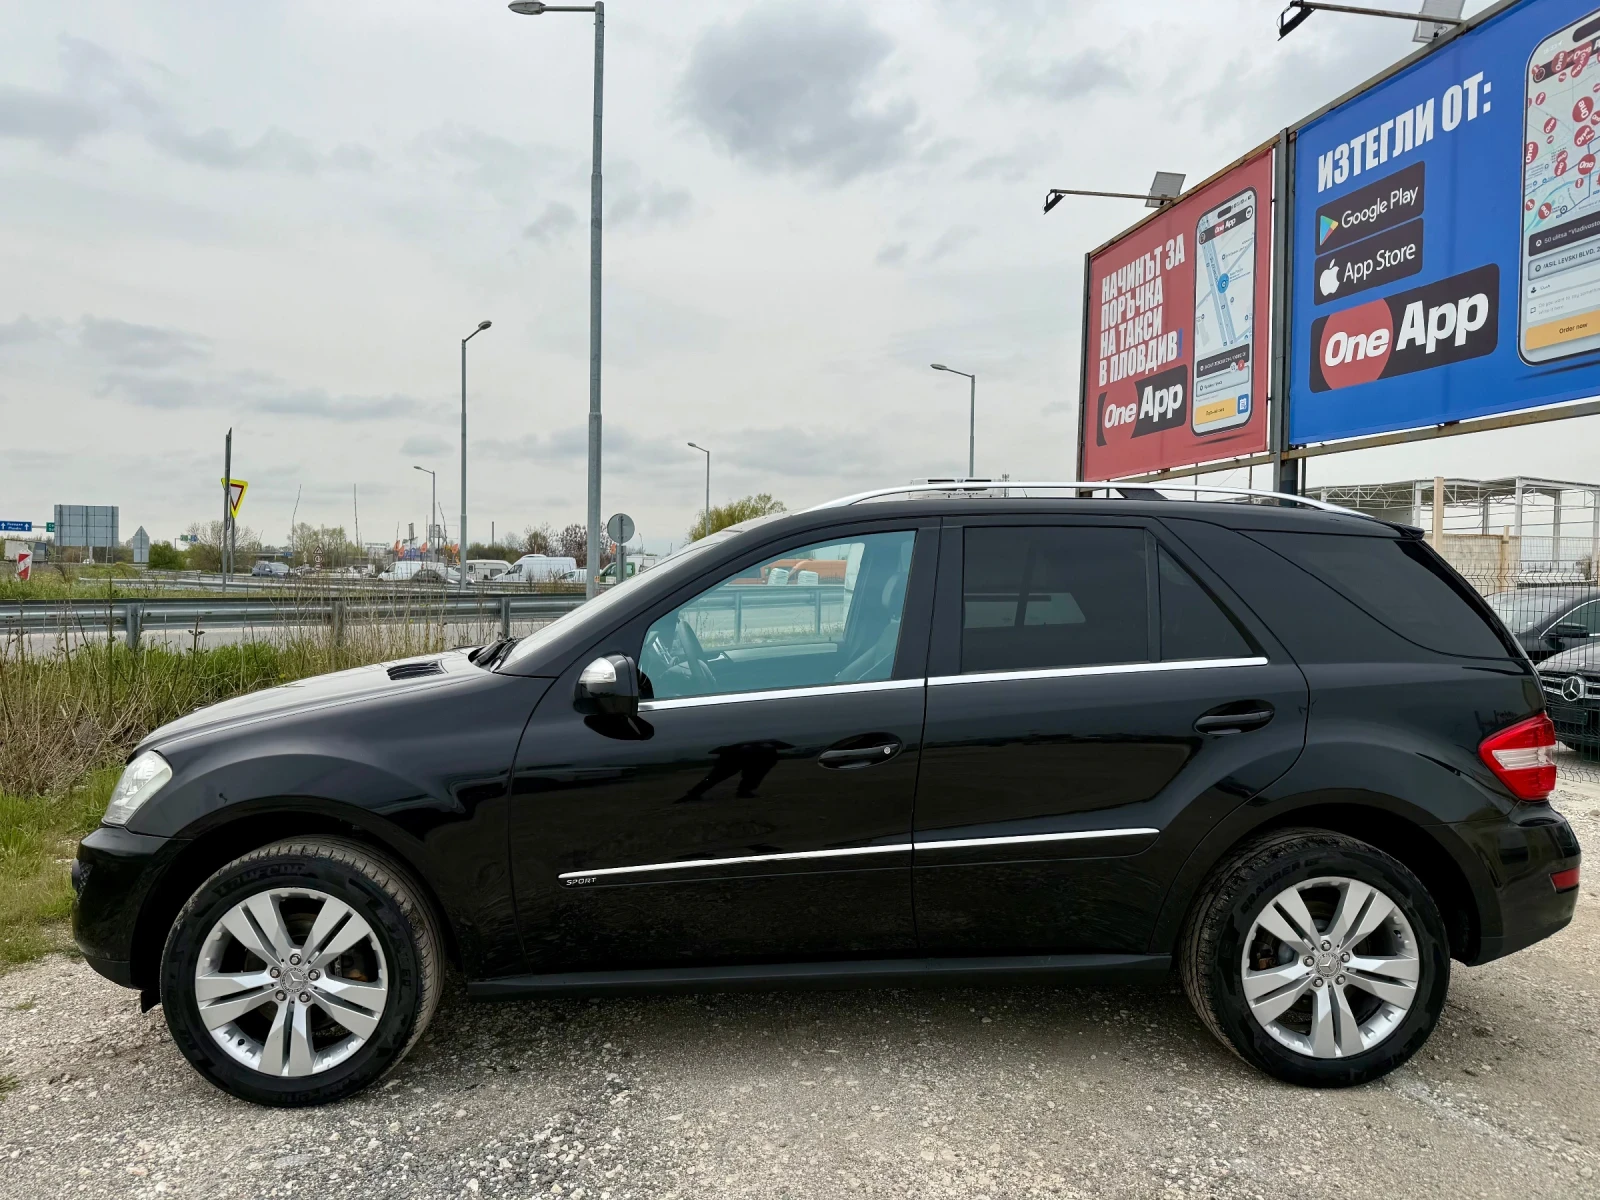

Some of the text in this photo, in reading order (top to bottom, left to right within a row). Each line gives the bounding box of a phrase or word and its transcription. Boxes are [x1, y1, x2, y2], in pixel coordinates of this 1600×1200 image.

[1318, 71, 1492, 193] ИЗТЕГЛИ ОТ:
[1579, 160, 1594, 169] One
[1341, 186, 1419, 229] Google Play
[1101, 246, 1163, 304] НАЧИНЪТ
[1165, 233, 1186, 271] ЗА
[1343, 243, 1416, 284] App Store
[1558, 253, 1578, 265] LEVSKI
[1101, 275, 1164, 331] ПОРЪЧКА
[1100, 304, 1163, 359] НА ТАКСИ
[1324, 292, 1489, 367] One App
[1559, 323, 1588, 334] Order now
[1099, 360, 1107, 387] В
[1104, 382, 1184, 428] One App
[566, 877, 597, 886] SPORT
